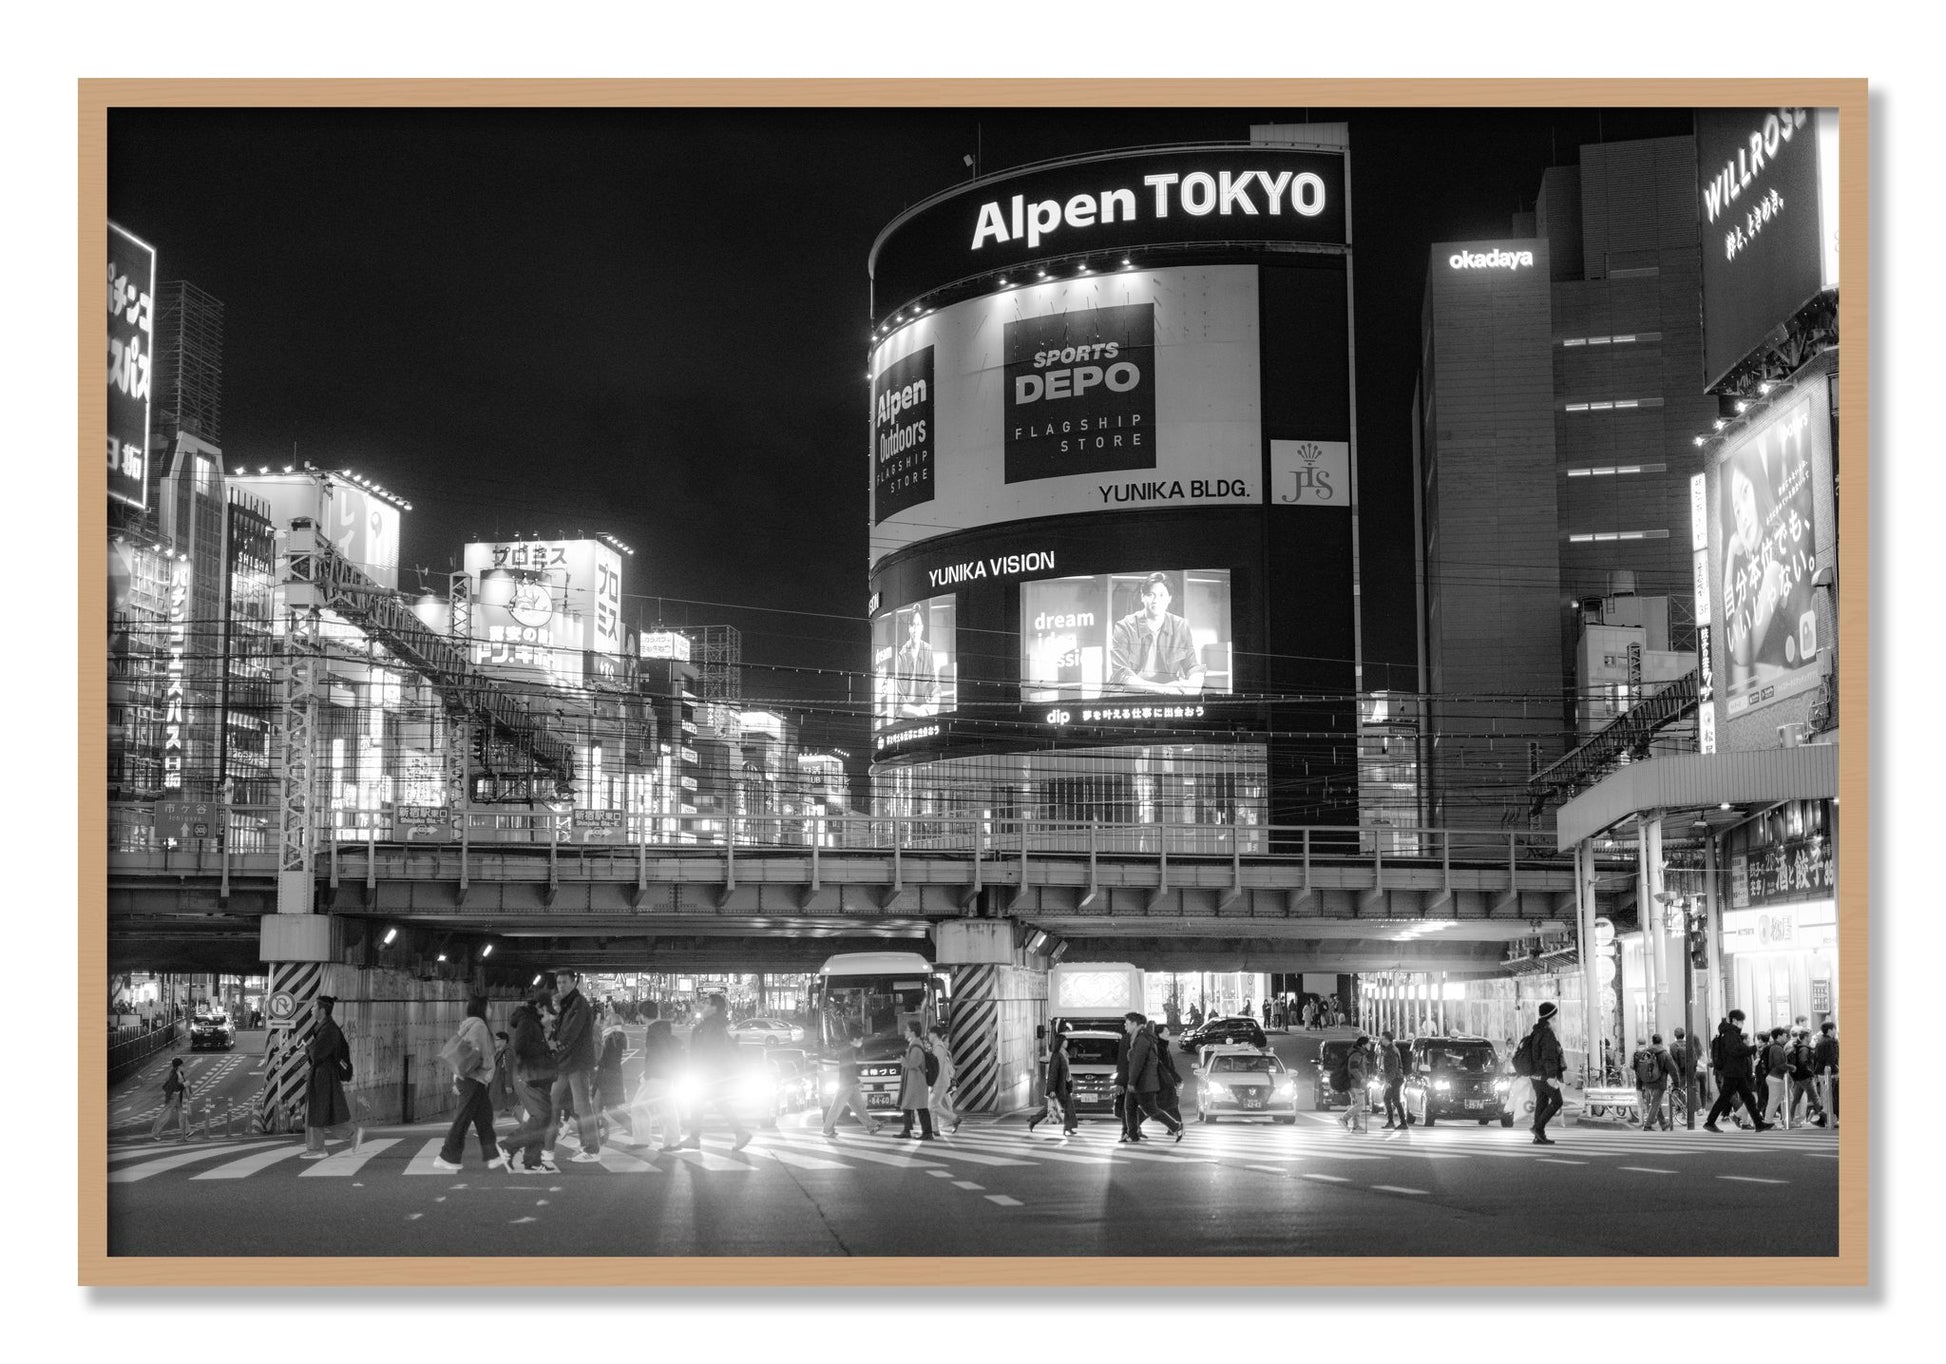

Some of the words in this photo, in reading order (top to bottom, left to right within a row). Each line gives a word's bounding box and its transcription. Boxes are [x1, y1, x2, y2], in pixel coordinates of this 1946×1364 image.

[971, 187, 1137, 250] Alpen
[1144, 171, 1325, 218] TOKYO
[1449, 248, 1533, 271] okadaya
[1033, 341, 1119, 368] SPORTS
[1015, 361, 1140, 405] DEPO
[877, 378, 927, 428] Alpen
[1015, 414, 1141, 440] FLAGSHIP
[880, 419, 926, 463] Outdoors
[1061, 433, 1141, 452] STORE
[876, 450, 928, 487] FLAGSHIP
[890, 468, 928, 493] STORE
[1098, 480, 1185, 503] YUNIKA
[1190, 479, 1251, 498] BLDG.
[492, 544, 567, 567] プロミス
[928, 560, 987, 588] YUNIKA
[989, 550, 1055, 576] VISION
[1034, 611, 1095, 631] dream
[1046, 709, 1070, 725] dip
[1082, 706, 1205, 722] 夢を叶える仕事に出会おう
